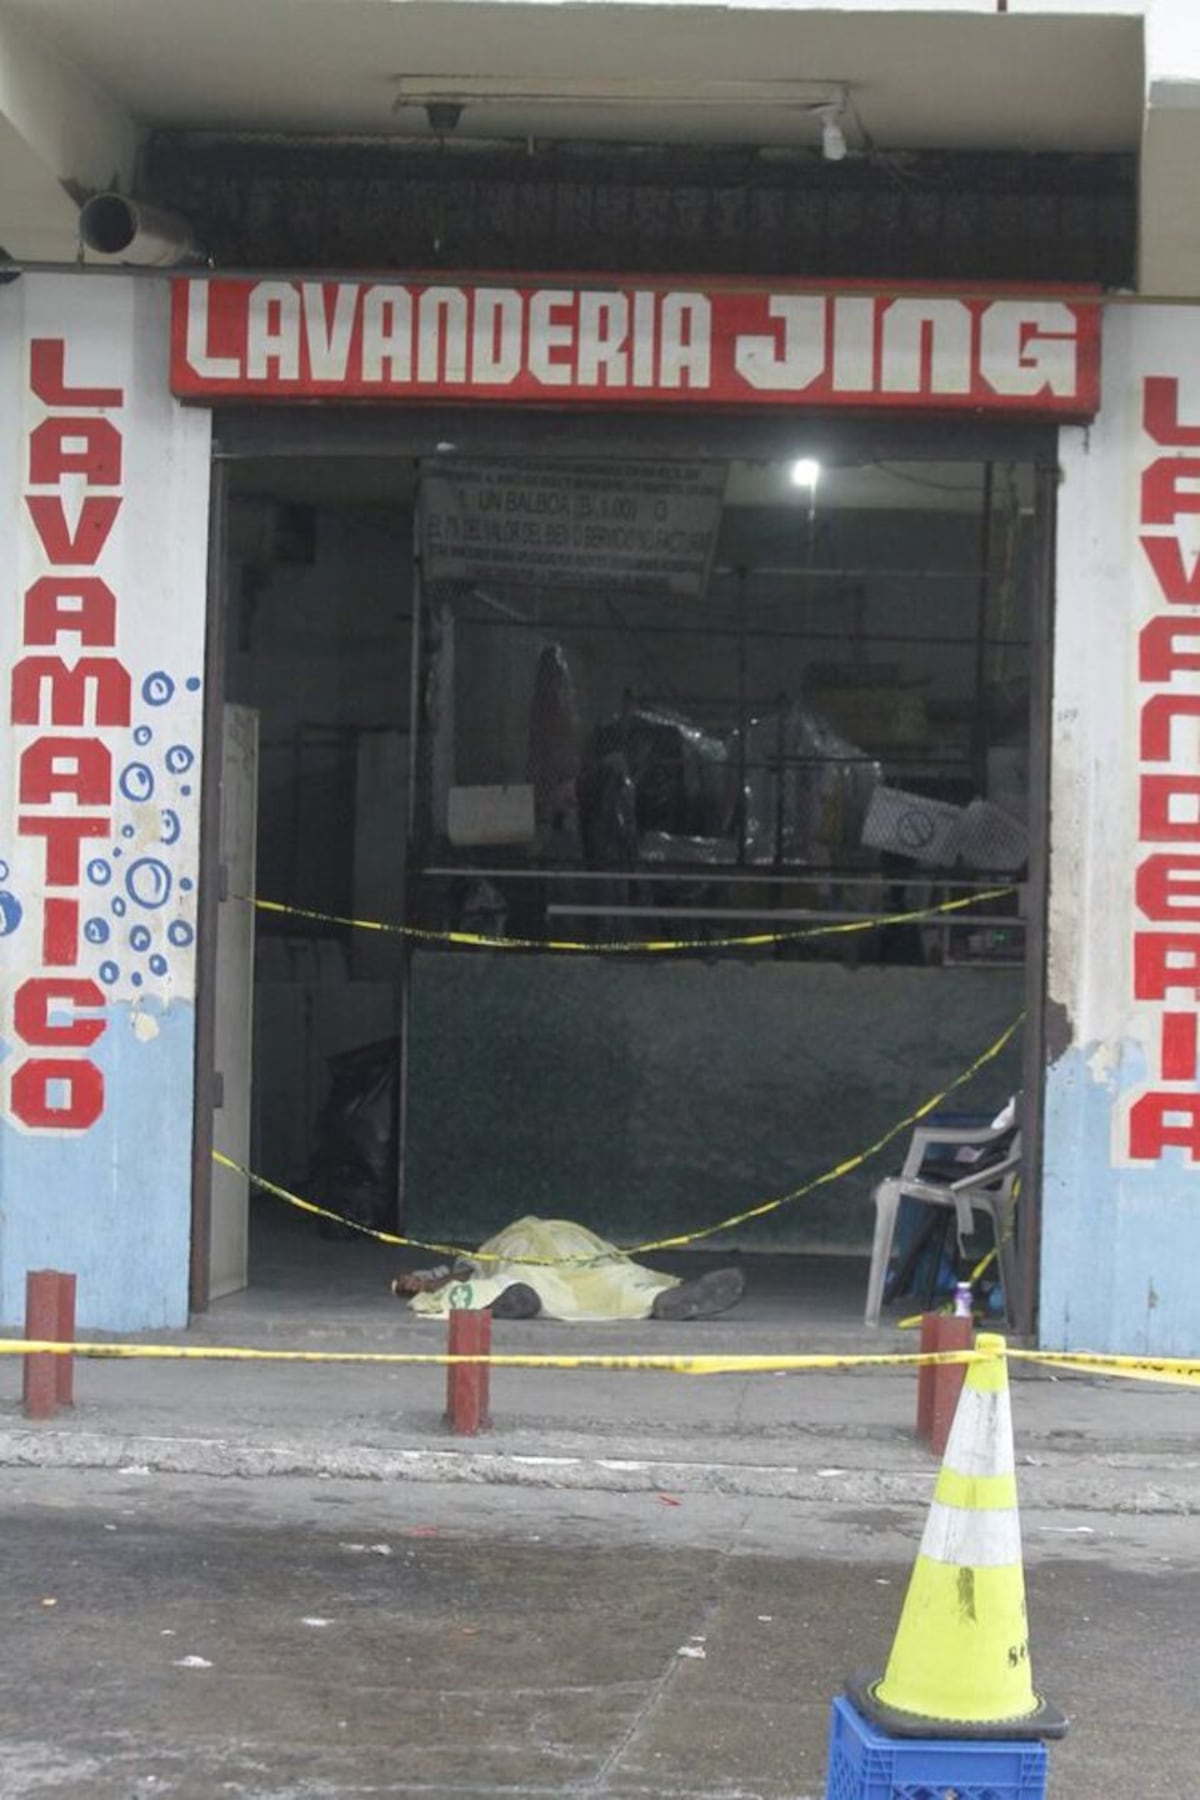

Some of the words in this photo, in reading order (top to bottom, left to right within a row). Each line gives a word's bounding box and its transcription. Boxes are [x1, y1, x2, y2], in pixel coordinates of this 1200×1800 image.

[186, 279, 712, 389] LAVANDERIA
[735, 293, 1078, 396] JING
[10, 338, 131, 1129] LAVAMATICO
